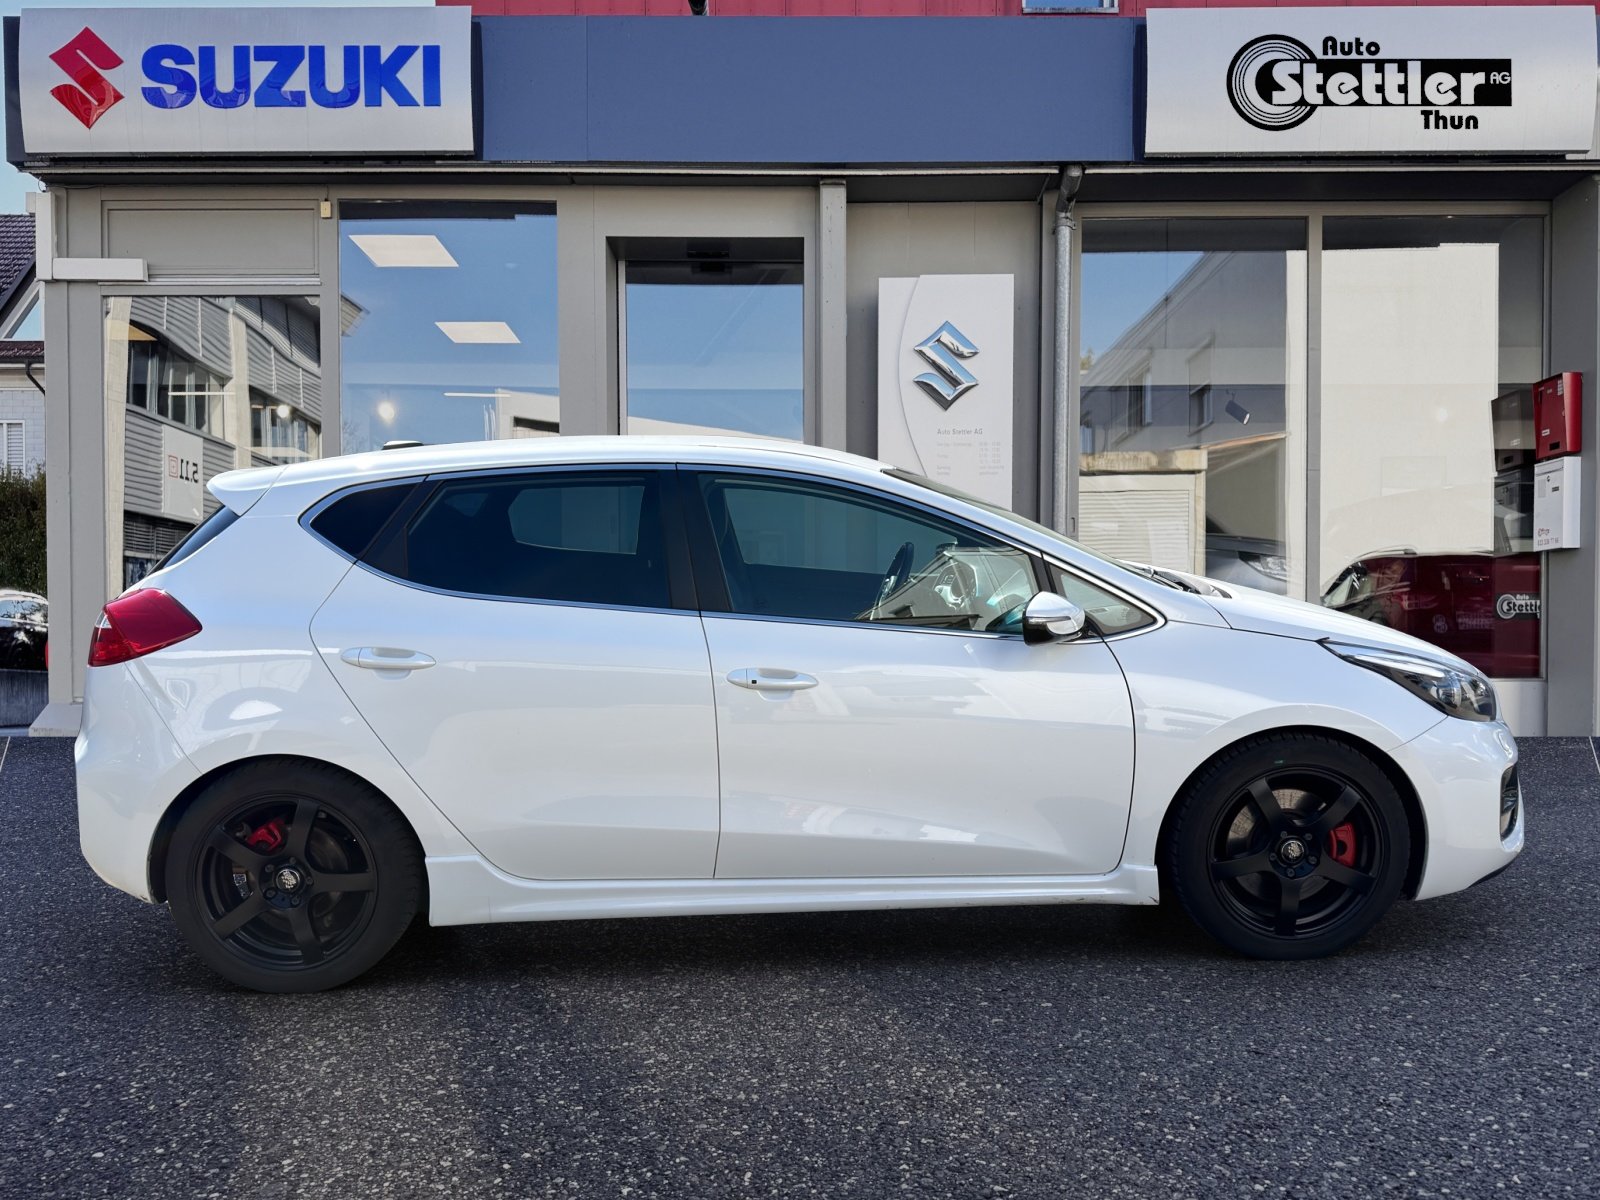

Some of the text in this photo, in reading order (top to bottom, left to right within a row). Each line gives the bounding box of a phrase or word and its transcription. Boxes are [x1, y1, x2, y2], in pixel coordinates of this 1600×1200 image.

[1322, 36, 1380, 56] Auto
[141, 44, 441, 109] SUZUKI
[1271, 60, 1511, 106] Stettler AG
[1421, 110, 1479, 130] Thun
